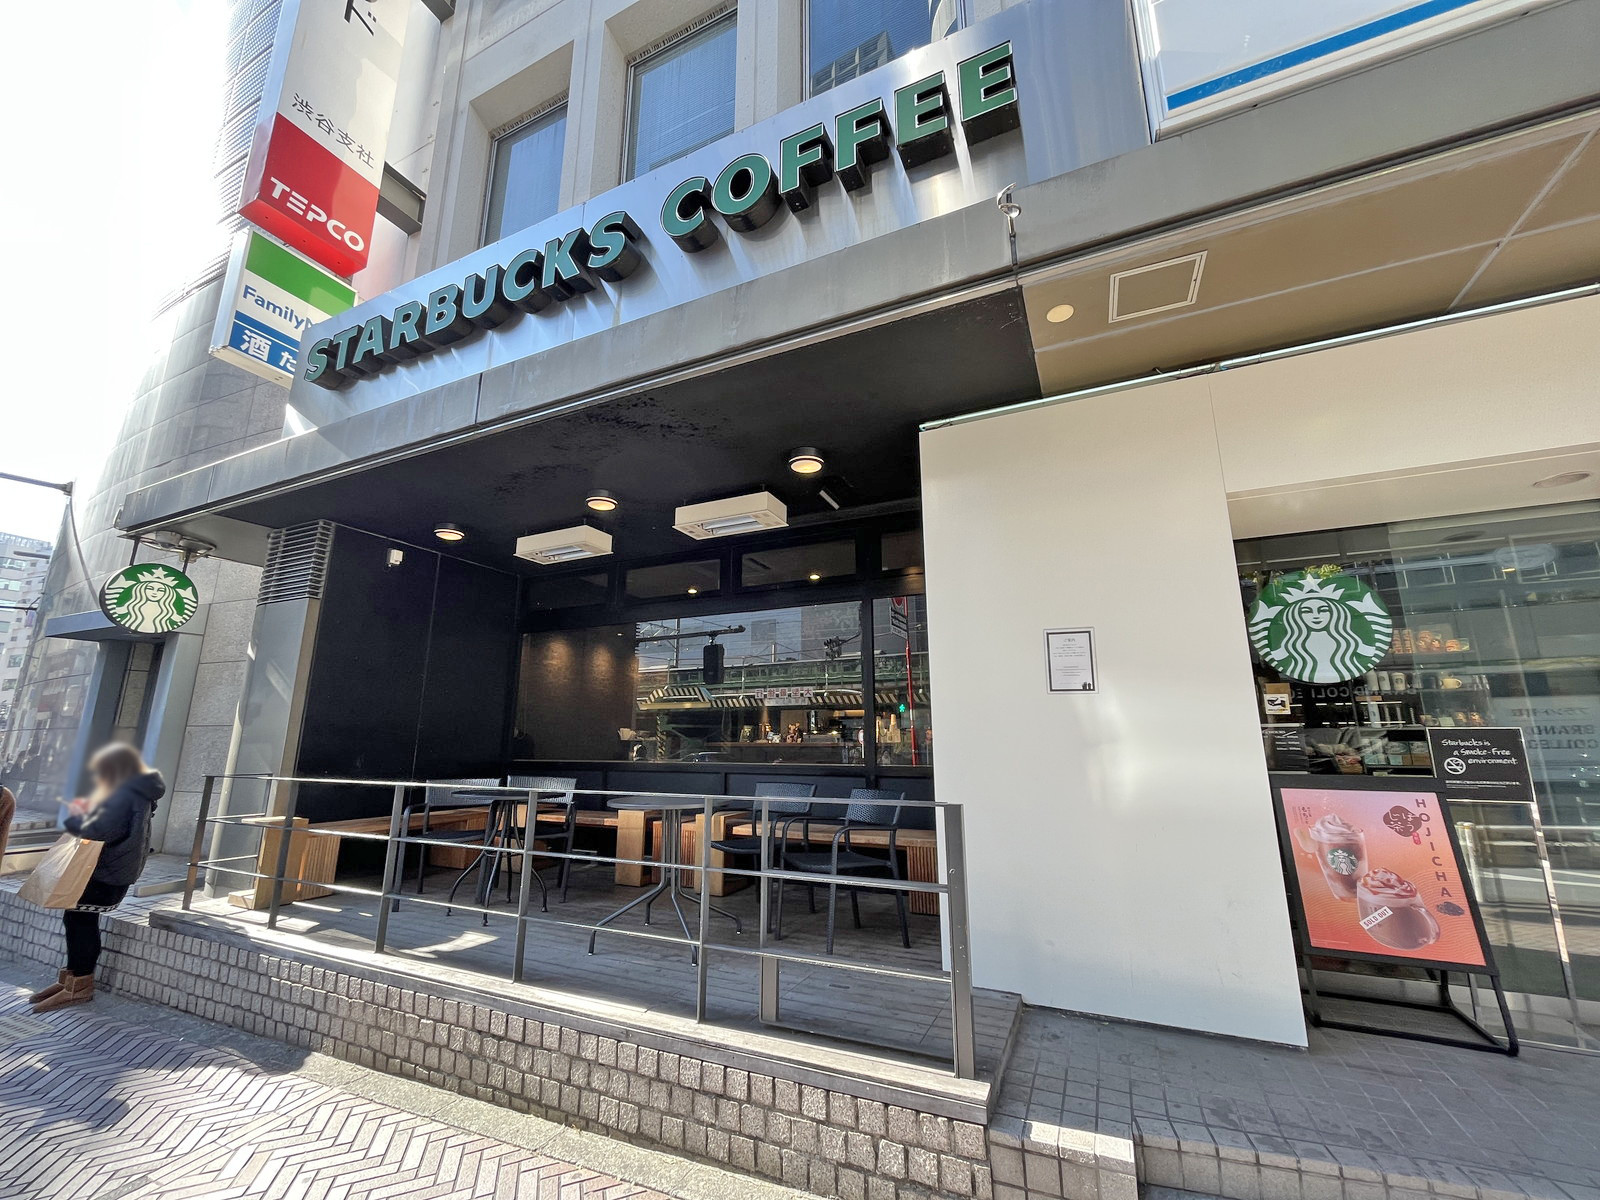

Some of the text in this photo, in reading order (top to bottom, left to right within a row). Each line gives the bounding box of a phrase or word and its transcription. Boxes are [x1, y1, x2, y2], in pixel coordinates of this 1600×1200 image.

[292, 93, 374, 169] 渋谷支社
[270, 177, 364, 252] TEPCO
[304, 40, 1018, 382] STARBUCKS COFFEE
[240, 329, 271, 361] 酒
[1441, 738, 1483, 746] Starbucks
[1415, 799, 1452, 897] HOJICHA
[1363, 908, 1390, 927] SOLD OUT
